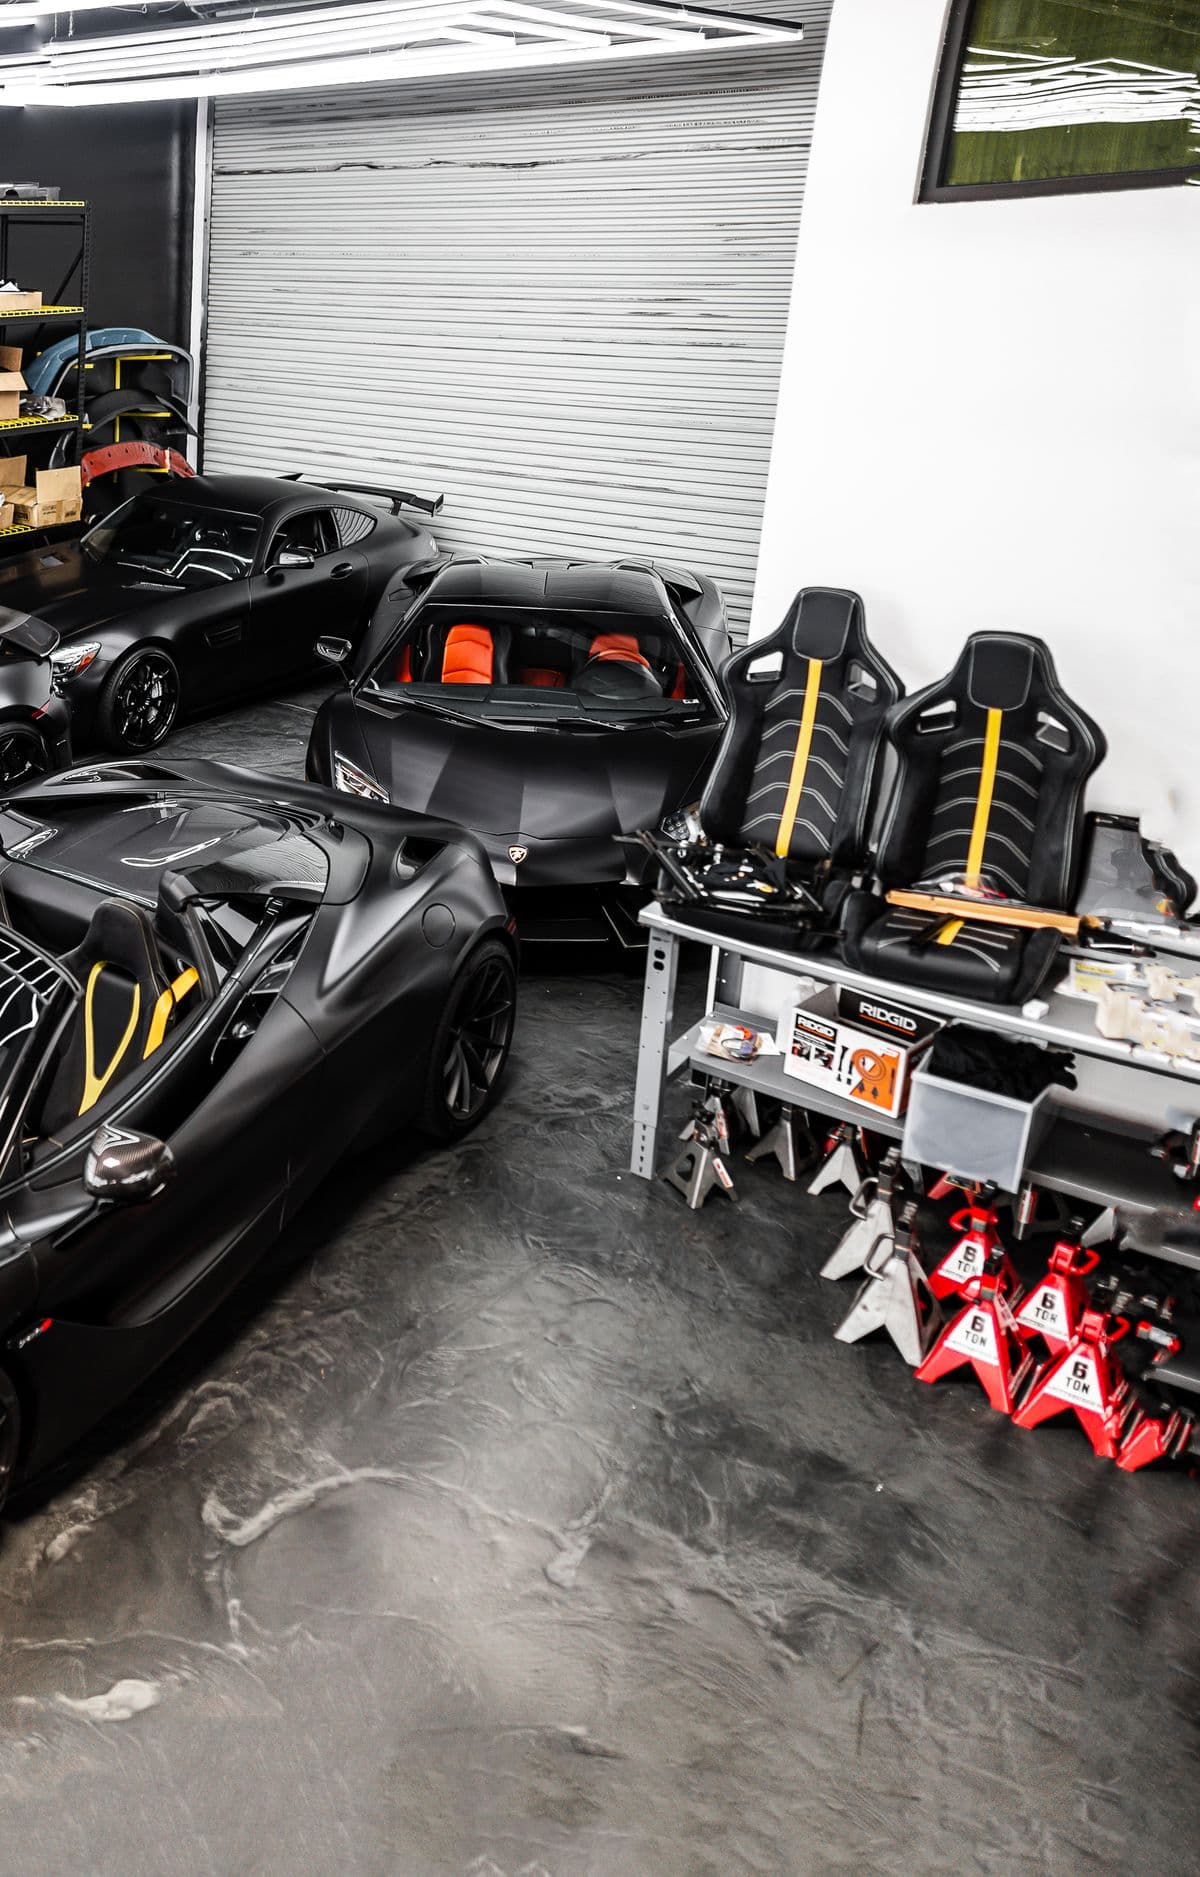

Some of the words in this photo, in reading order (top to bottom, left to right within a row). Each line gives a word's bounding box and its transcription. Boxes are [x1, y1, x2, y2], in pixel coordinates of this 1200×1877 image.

[859, 1002, 918, 1031] RIDGID
[797, 1017, 836, 1037] RIDGID
[963, 1246, 977, 1262] 6
[1042, 1292, 1056, 1309] 6
[1035, 1307, 1058, 1322] TON
[971, 1315, 985, 1332] 6
[965, 1331, 988, 1347] TON
[1072, 1361, 1088, 1379] 6
[1065, 1377, 1090, 1394] TON
